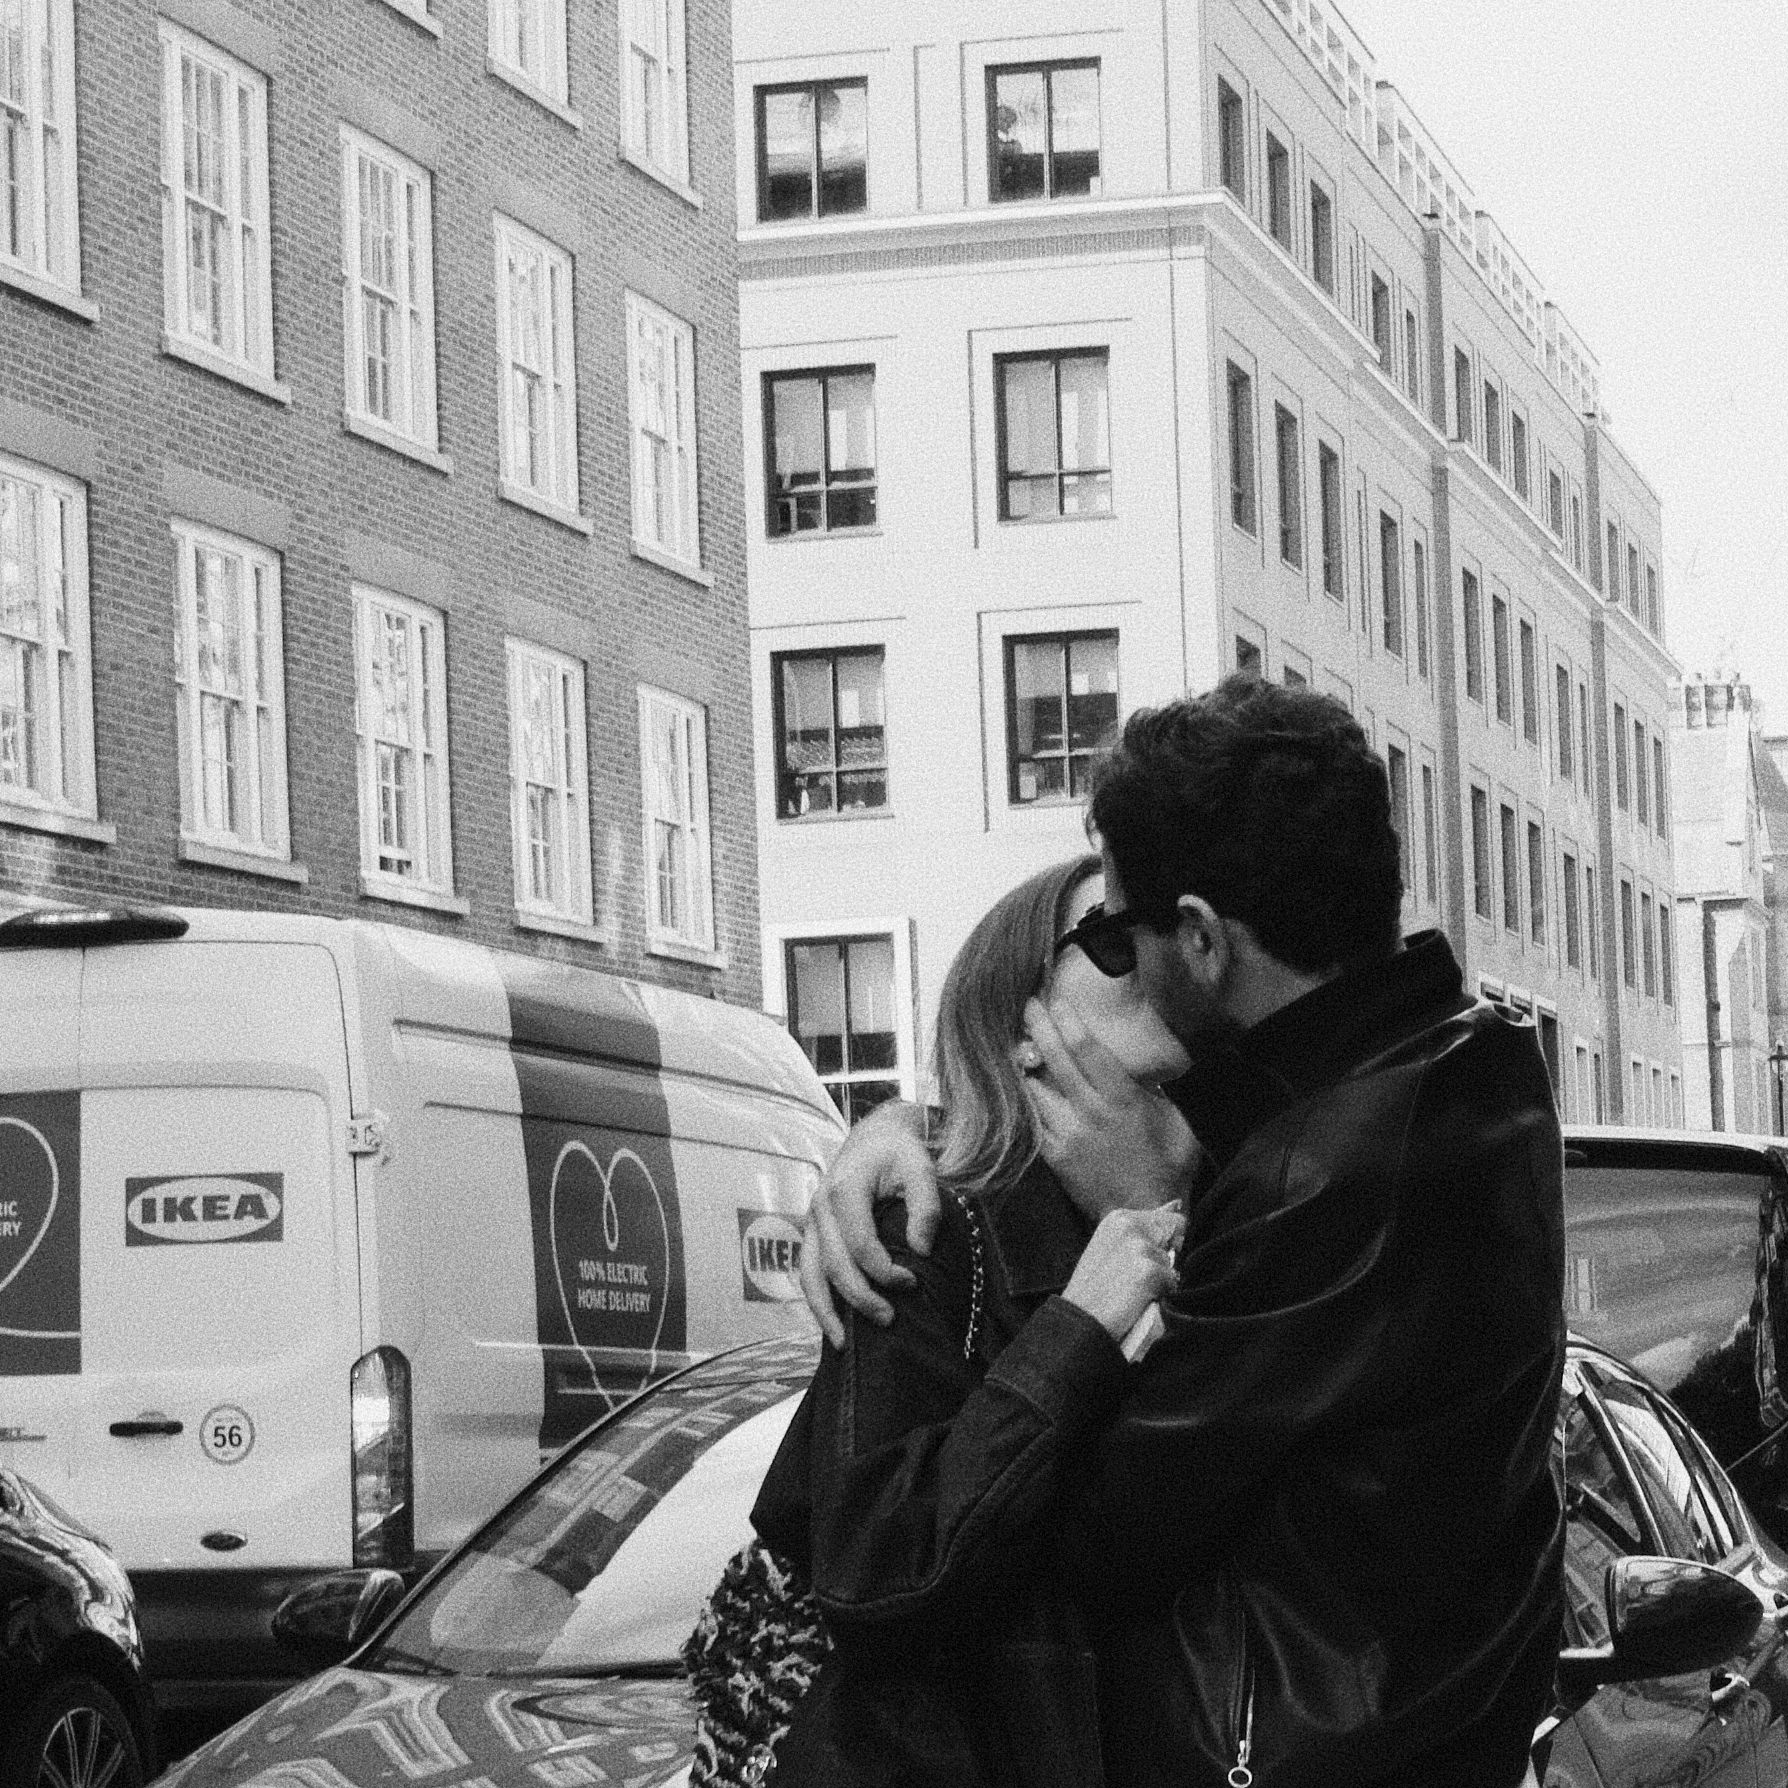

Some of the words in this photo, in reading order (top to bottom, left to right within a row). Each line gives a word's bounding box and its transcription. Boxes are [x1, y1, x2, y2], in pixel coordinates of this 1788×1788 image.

[141, 1193, 270, 1224] IKEA
[579, 1260, 605, 1281] 100%
[606, 1262, 648, 1285] ELECTRIC
[578, 1288, 607, 1310] HOME
[608, 1290, 651, 1312] DELIVERY
[214, 1425, 242, 1448] 56
